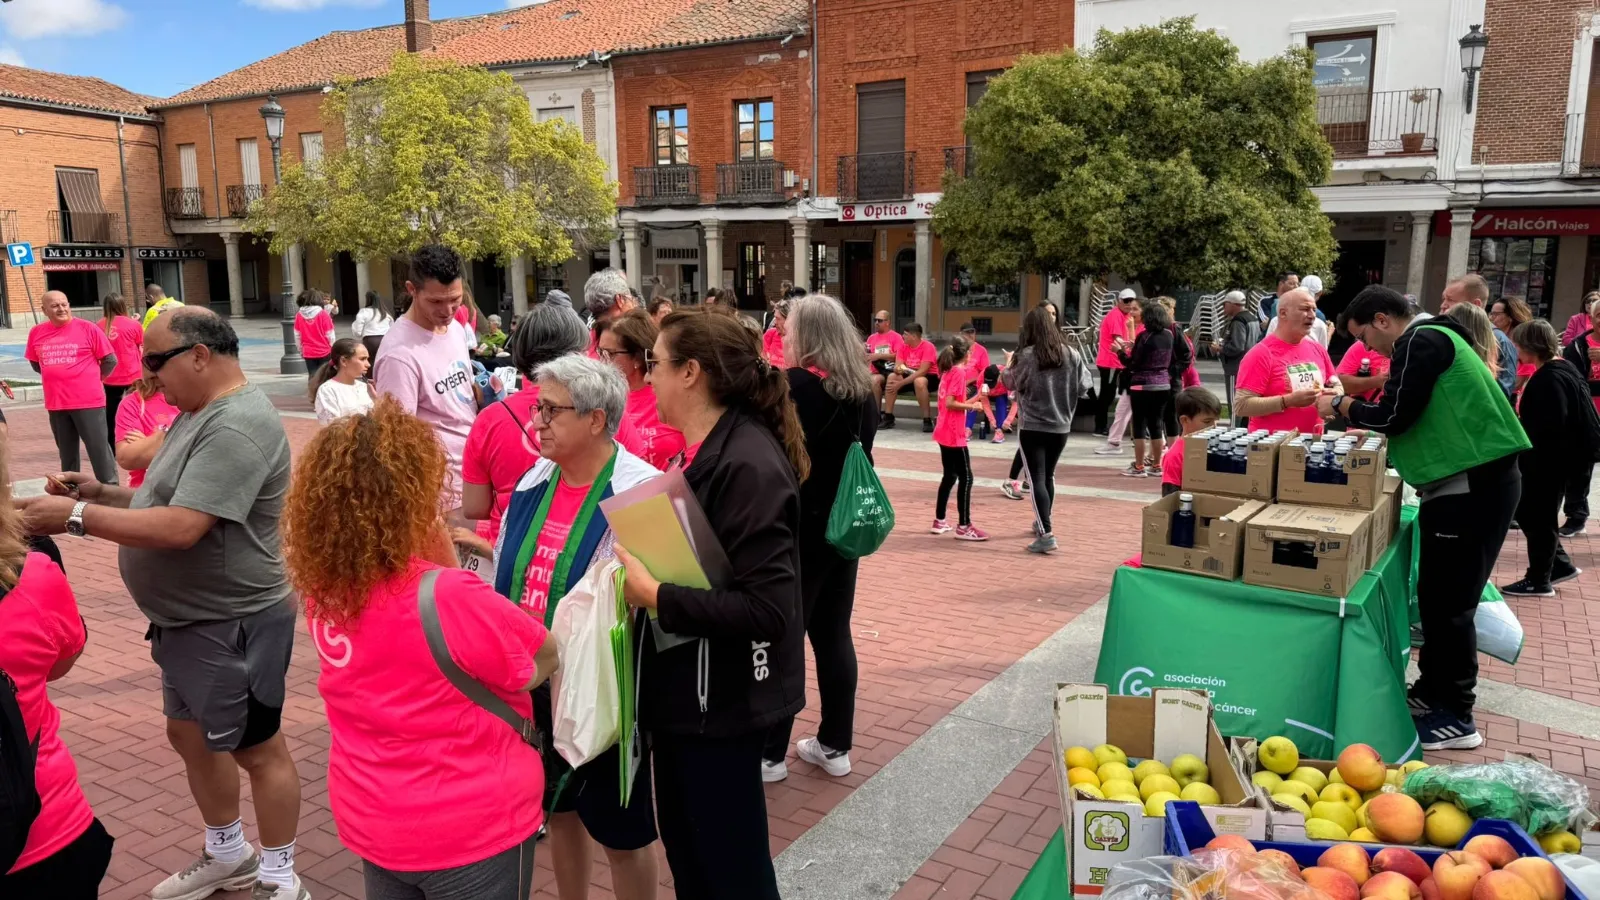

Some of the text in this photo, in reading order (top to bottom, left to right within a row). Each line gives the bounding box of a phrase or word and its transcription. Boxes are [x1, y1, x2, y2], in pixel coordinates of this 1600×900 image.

[1494, 216, 1590, 231] Halcón viajes
[12, 245, 27, 264] P
[48, 249, 205, 258] MUEBLES CASTILLO
[434, 371, 468, 394] CYBER
[1163, 673, 1227, 687] asociación
[1214, 702, 1257, 716] cáncer
